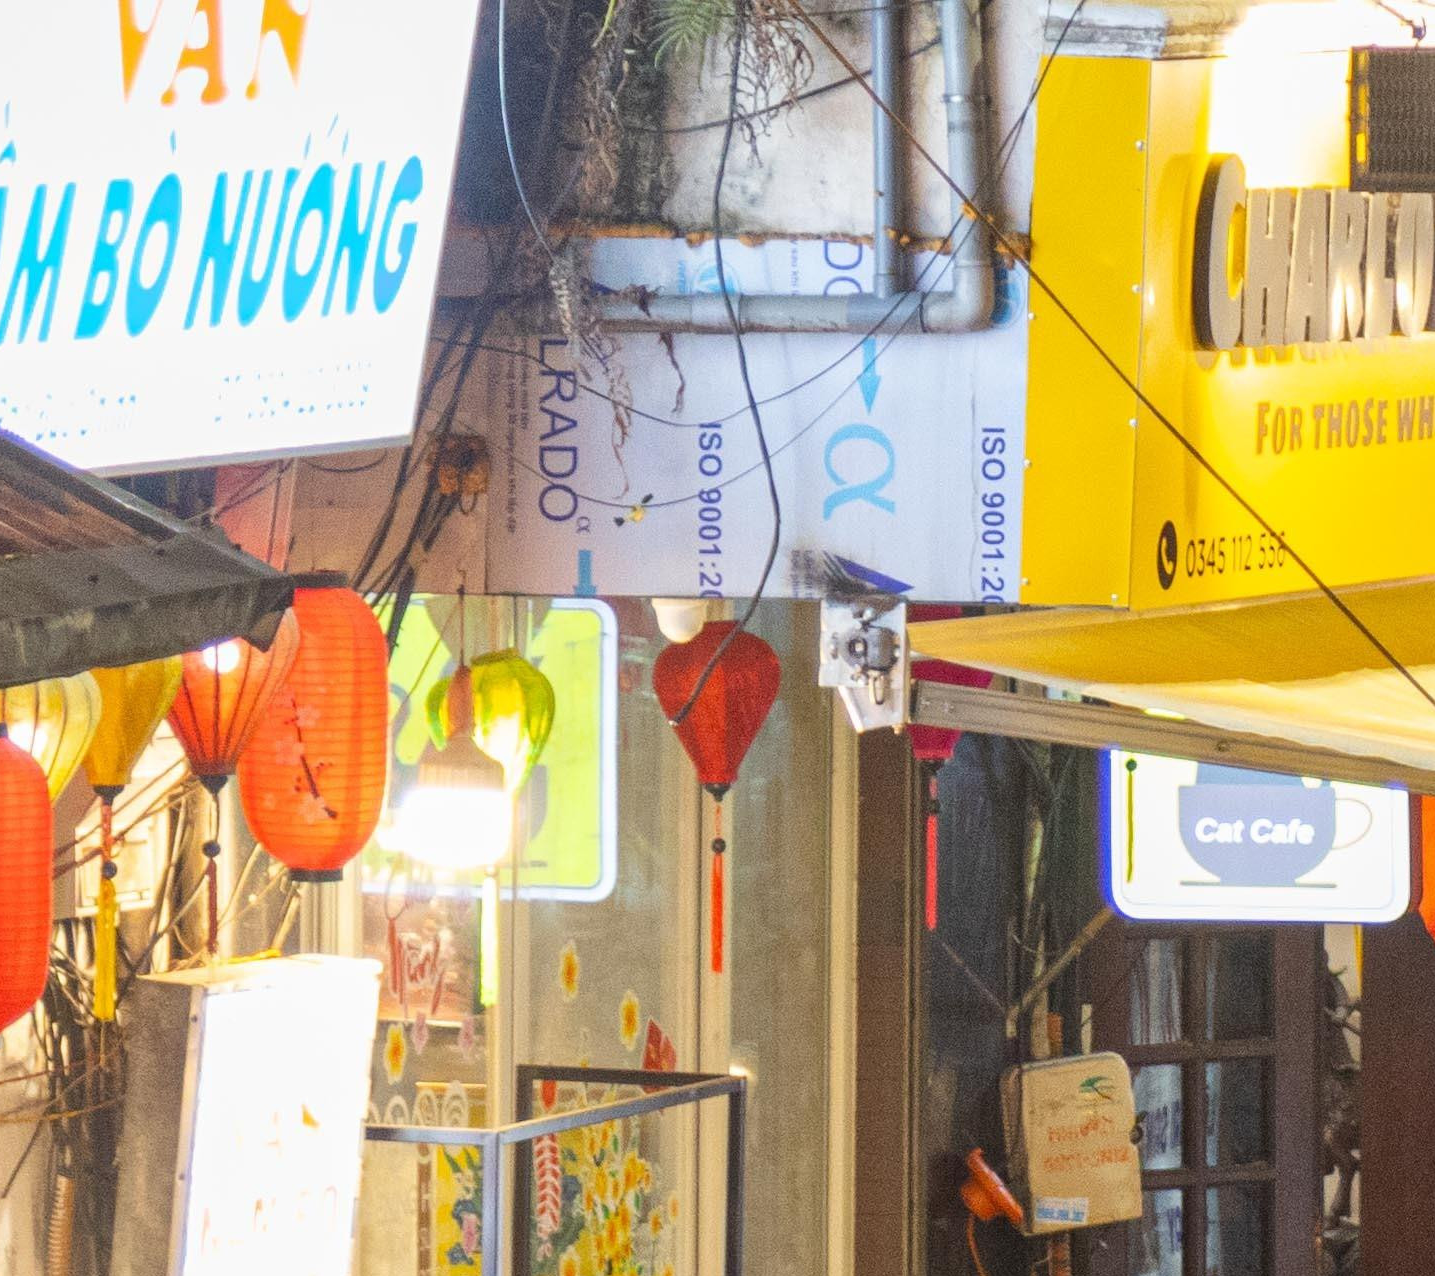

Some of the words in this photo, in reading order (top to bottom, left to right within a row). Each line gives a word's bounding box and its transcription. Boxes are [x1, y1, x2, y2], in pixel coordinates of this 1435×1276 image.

[697, 421, 723, 476] ISO
[1255, 399, 1303, 456] FOR
[1313, 393, 1389, 450] THOSE
[981, 427, 1006, 481] ISO
[1185, 537, 1226, 578] 0345
[1194, 816, 1245, 843] Cat
[1249, 818, 1315, 845] Cafe
